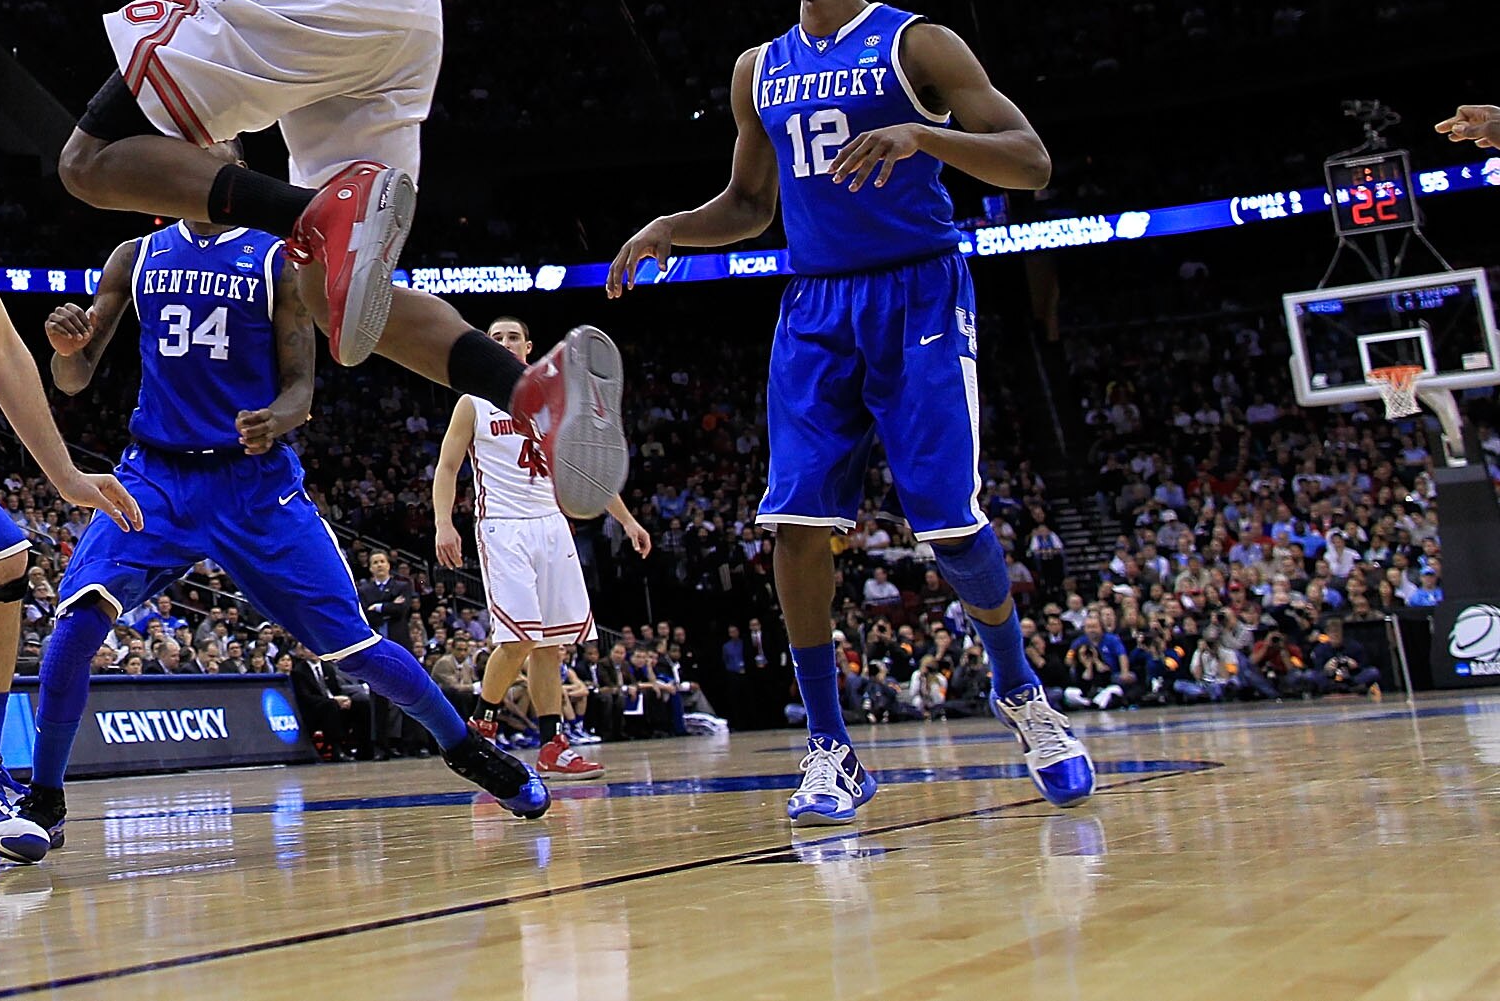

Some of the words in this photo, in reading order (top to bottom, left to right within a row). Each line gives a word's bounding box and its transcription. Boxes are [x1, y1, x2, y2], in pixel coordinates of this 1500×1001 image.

[760, 67, 887, 109] KENTUCKY
[786, 108, 851, 178] 12
[411, 268, 441, 282] 2011
[442, 265, 531, 281] BASKETBALL
[729, 256, 778, 275] NCAA
[143, 269, 260, 303] KENTUCKY
[411, 277, 534, 294] CHAMPIONSHIP
[158, 304, 230, 361] 34
[489, 419, 514, 437] OHI
[95, 708, 229, 744] KENTUCKY
[268, 715, 299, 732] NCAA
